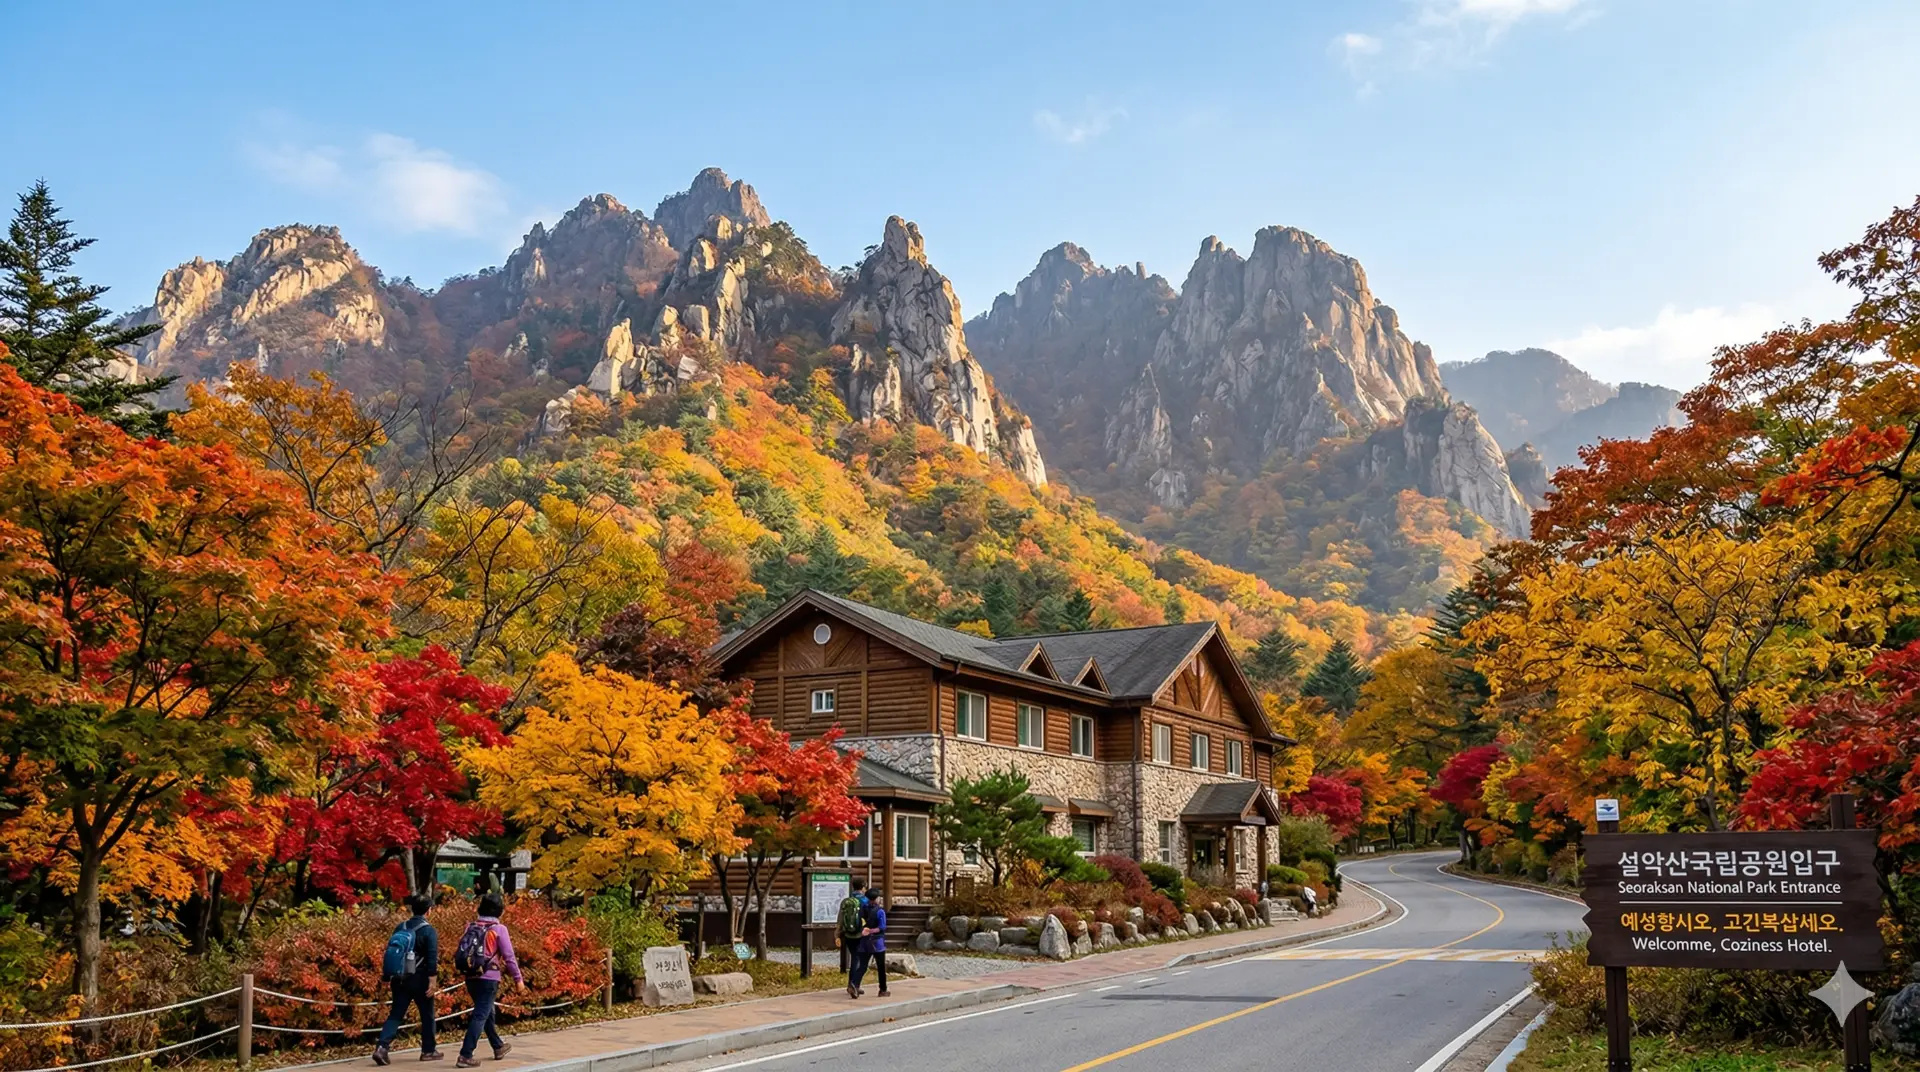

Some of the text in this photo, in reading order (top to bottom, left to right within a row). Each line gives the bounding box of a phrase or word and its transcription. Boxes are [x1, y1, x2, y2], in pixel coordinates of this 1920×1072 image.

[1618, 849, 1841, 877] 설악산국립공원입구
[1618, 880, 1841, 894] Seoraksan National Park Entrance
[1620, 912, 1844, 933] 예성항시오, 고긴복삽세오.
[1632, 936, 1832, 953] Welcomme, Coziness Hotel.
